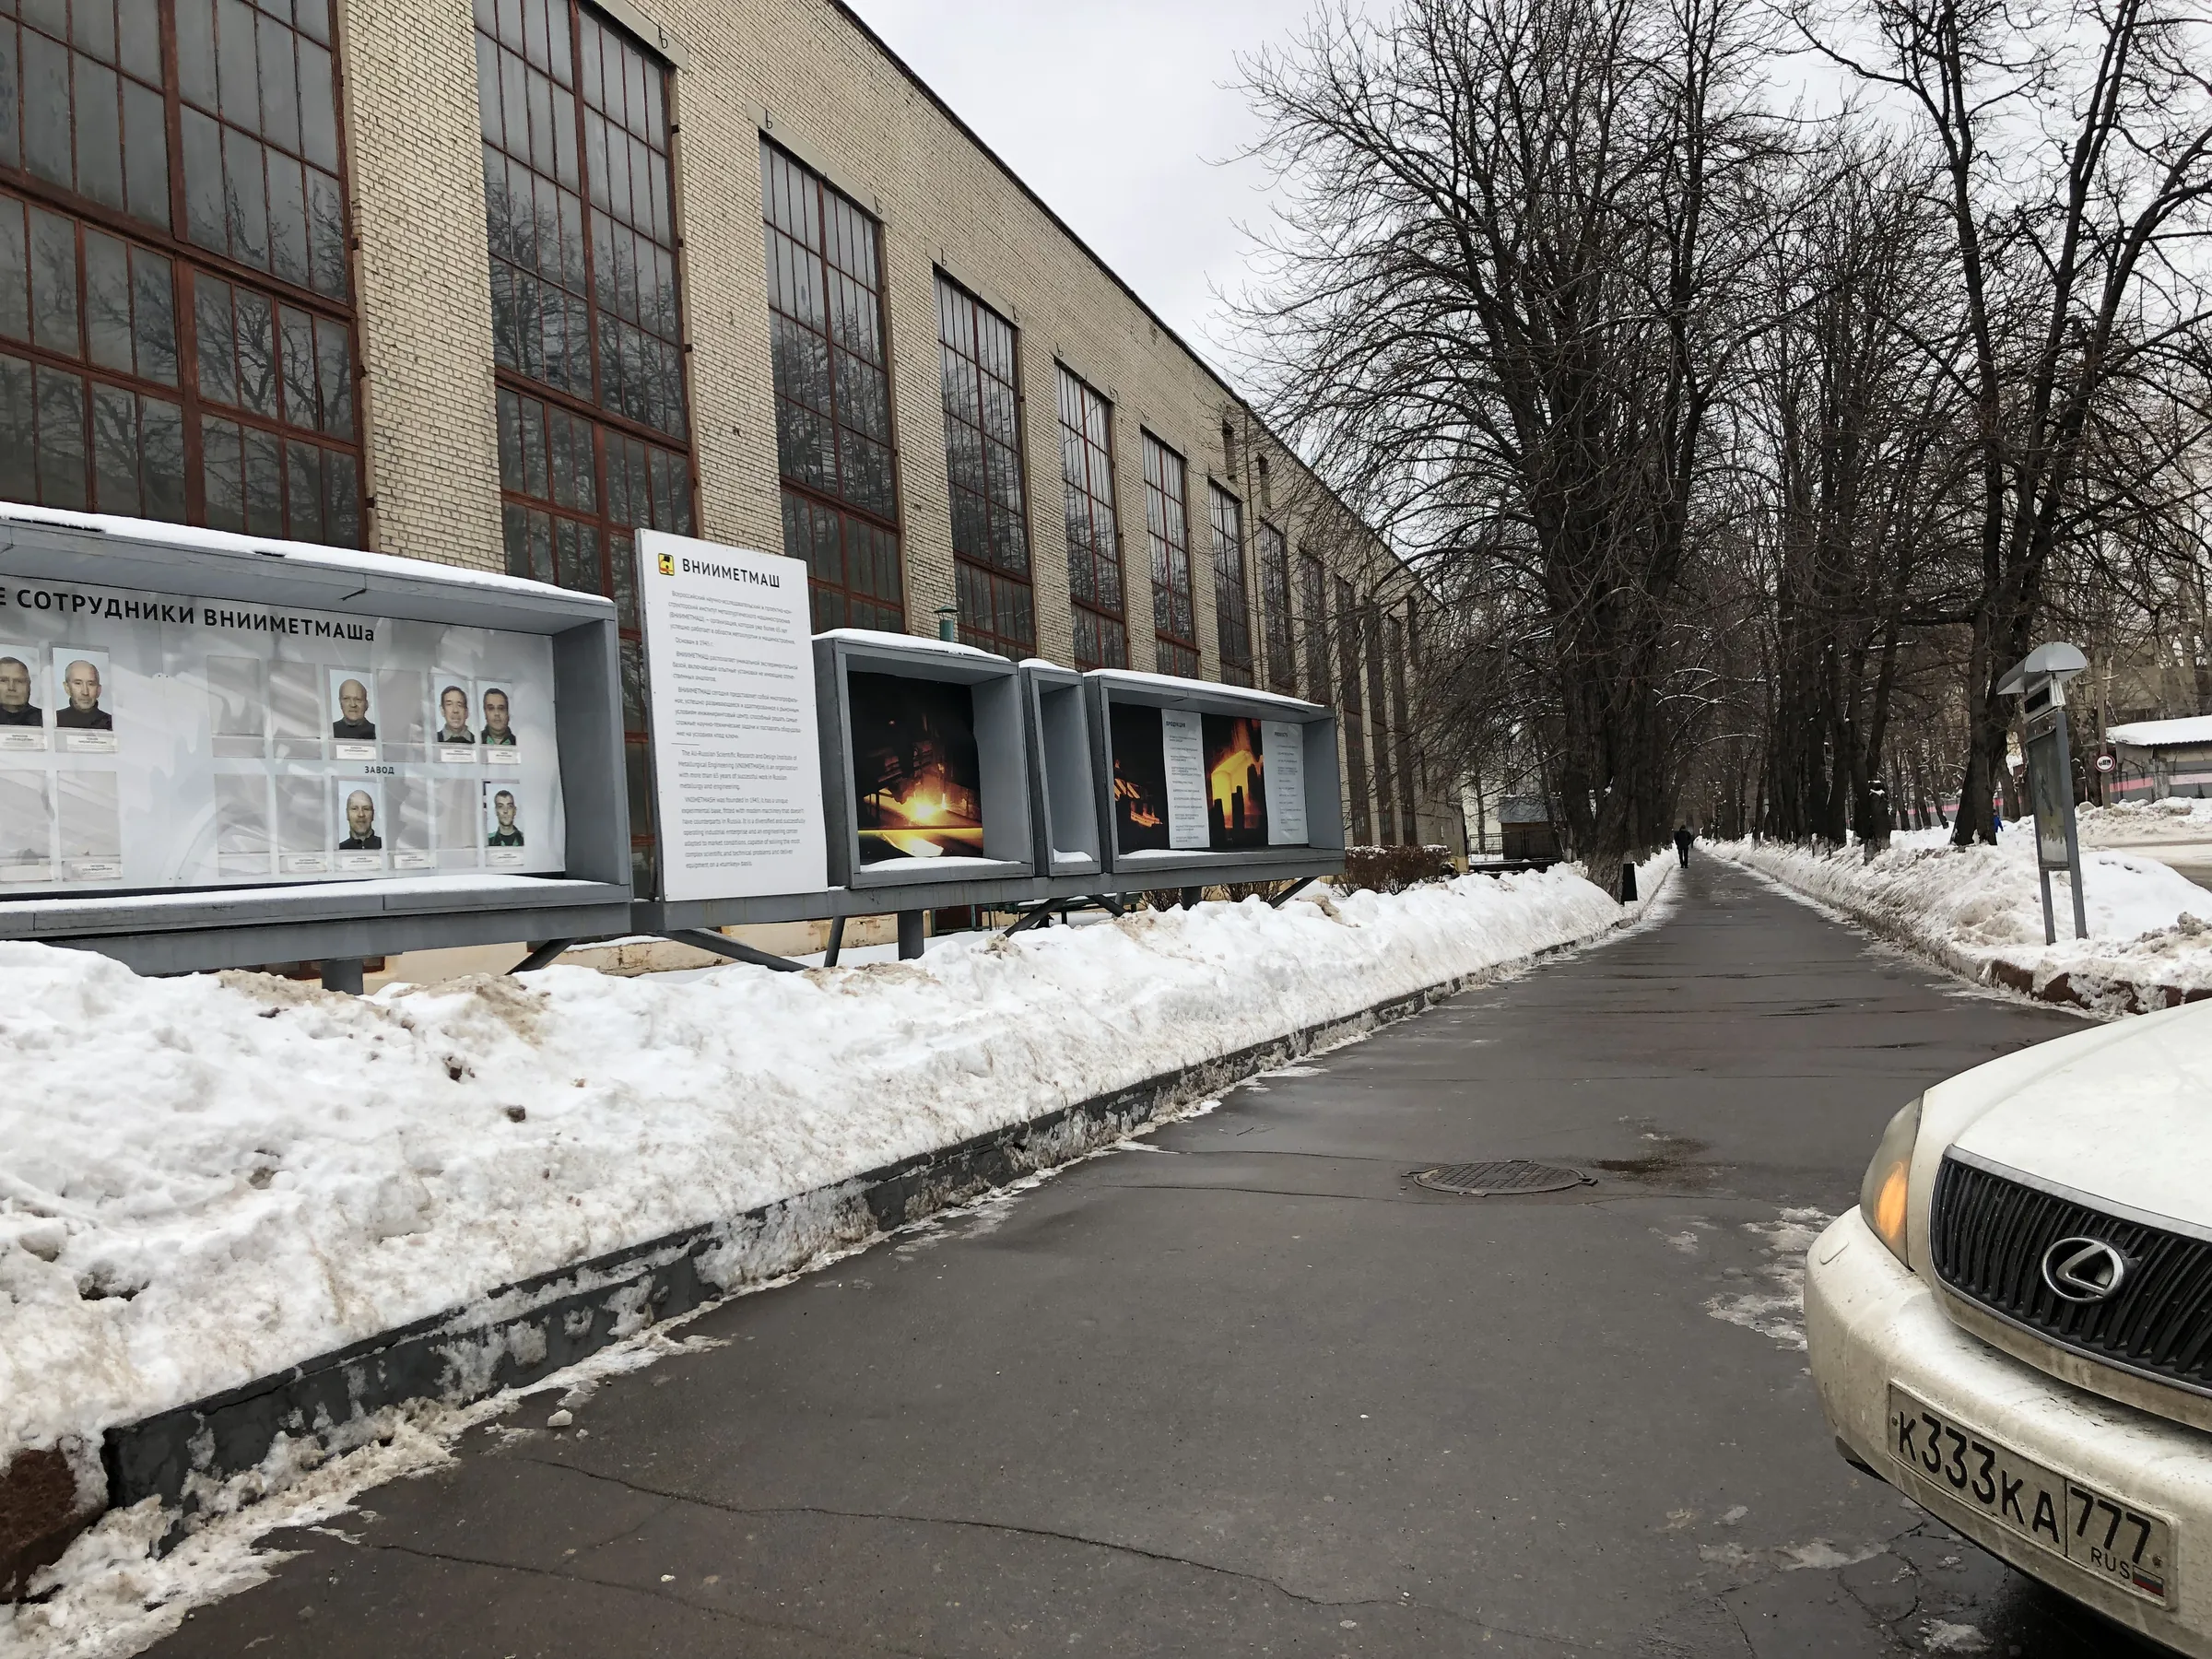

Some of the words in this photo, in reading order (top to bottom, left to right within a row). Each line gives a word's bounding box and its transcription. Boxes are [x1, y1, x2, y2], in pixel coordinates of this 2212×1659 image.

[683, 559, 780, 588] ВНИИМЕТМАШ
[17, 589, 194, 624] СОТРУДНИКИ
[204, 607, 374, 641] ВНИИМЕТМАШа
[364, 765, 394, 775] ЗАВОД
[1898, 1410, 2059, 1544] К333КА
[2070, 1487, 2151, 1564] 777
[2090, 1547, 2130, 1580] RUS
